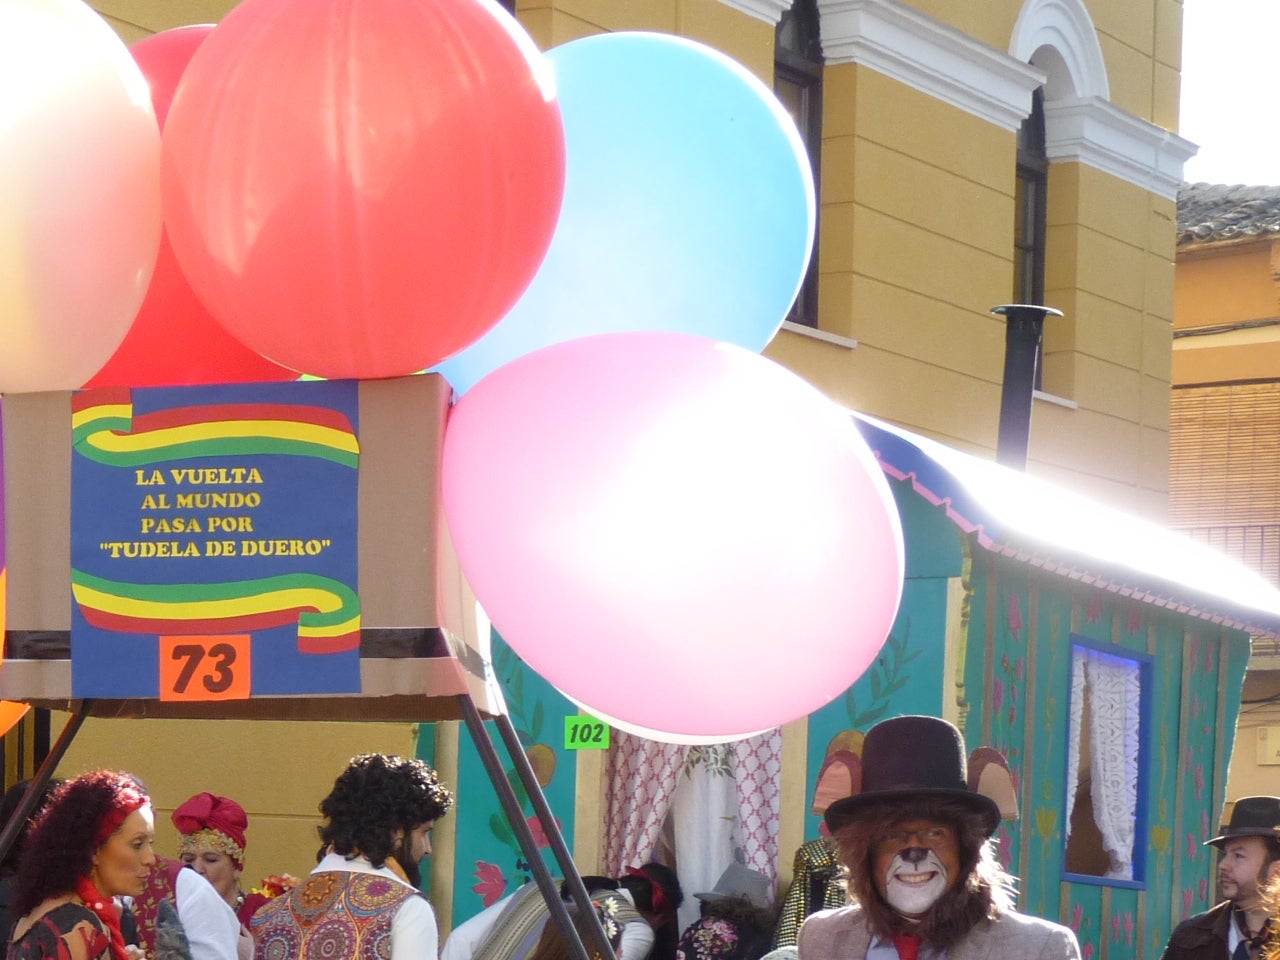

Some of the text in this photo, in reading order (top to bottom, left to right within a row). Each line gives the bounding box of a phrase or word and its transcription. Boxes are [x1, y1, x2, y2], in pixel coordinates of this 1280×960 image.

[136, 468, 263, 485] LA VUELTA
[141, 493, 261, 509] AL MUNDO
[141, 517, 254, 533] PASA POR
[100, 540, 330, 557] "TUDELA DE DUERO"
[172, 643, 237, 694] 73
[570, 723, 604, 743] 102
